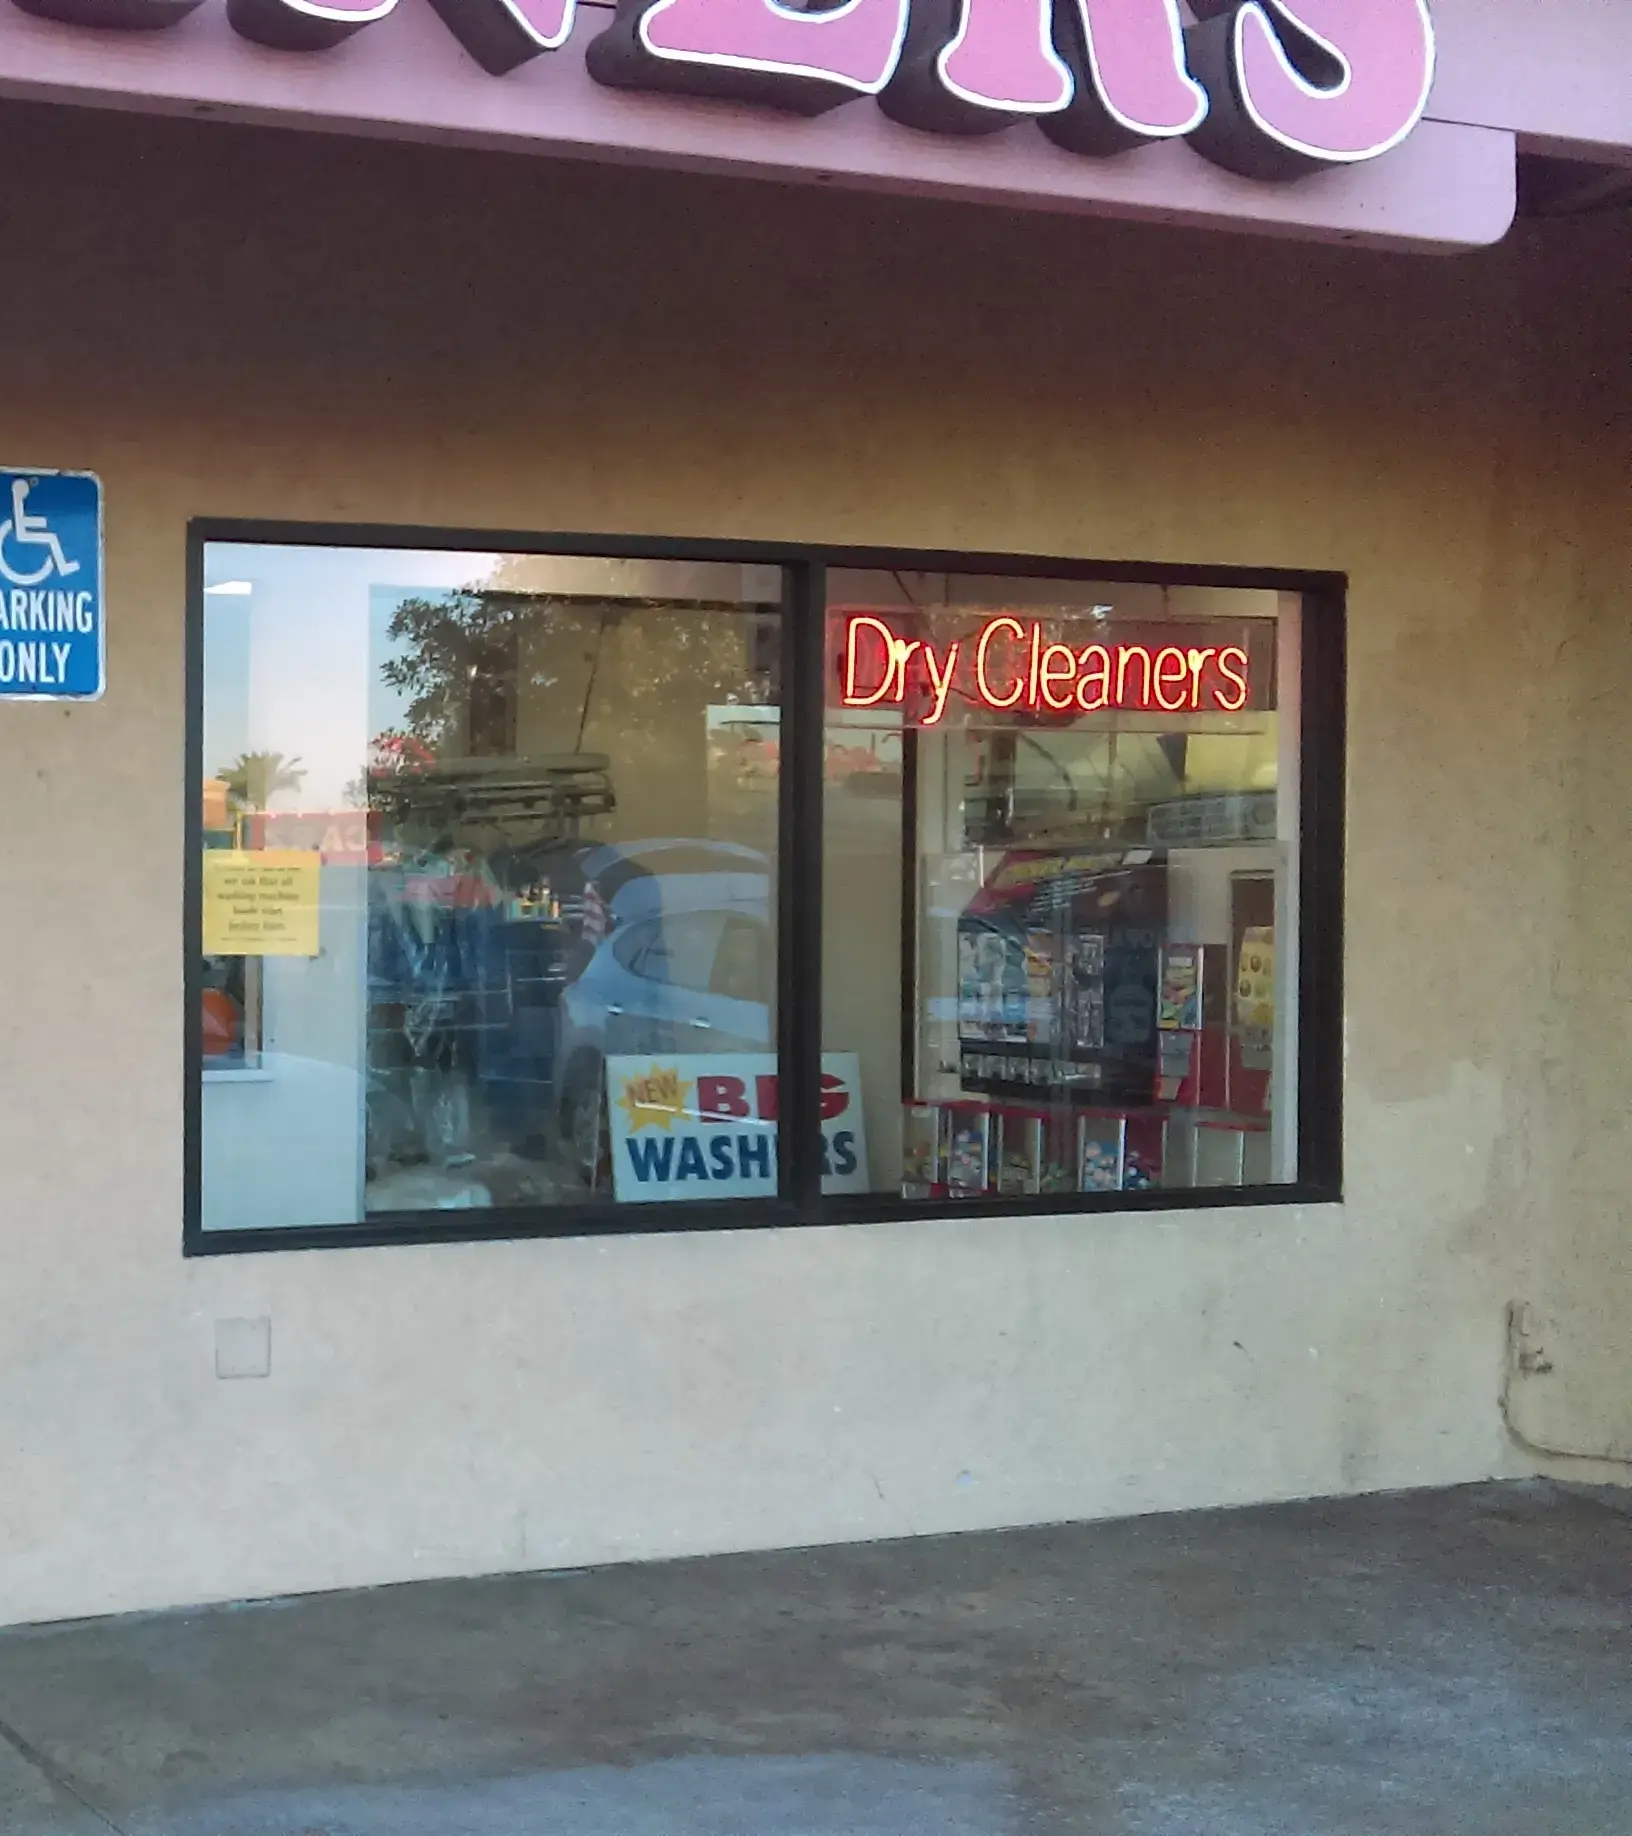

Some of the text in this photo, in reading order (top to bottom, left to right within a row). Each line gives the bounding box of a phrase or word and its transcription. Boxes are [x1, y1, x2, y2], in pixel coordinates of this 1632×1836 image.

[842, 615, 1251, 726] Dry Cleaners
[625, 1074, 679, 1106] NEW
[625, 1130, 858, 1182] WASHS
